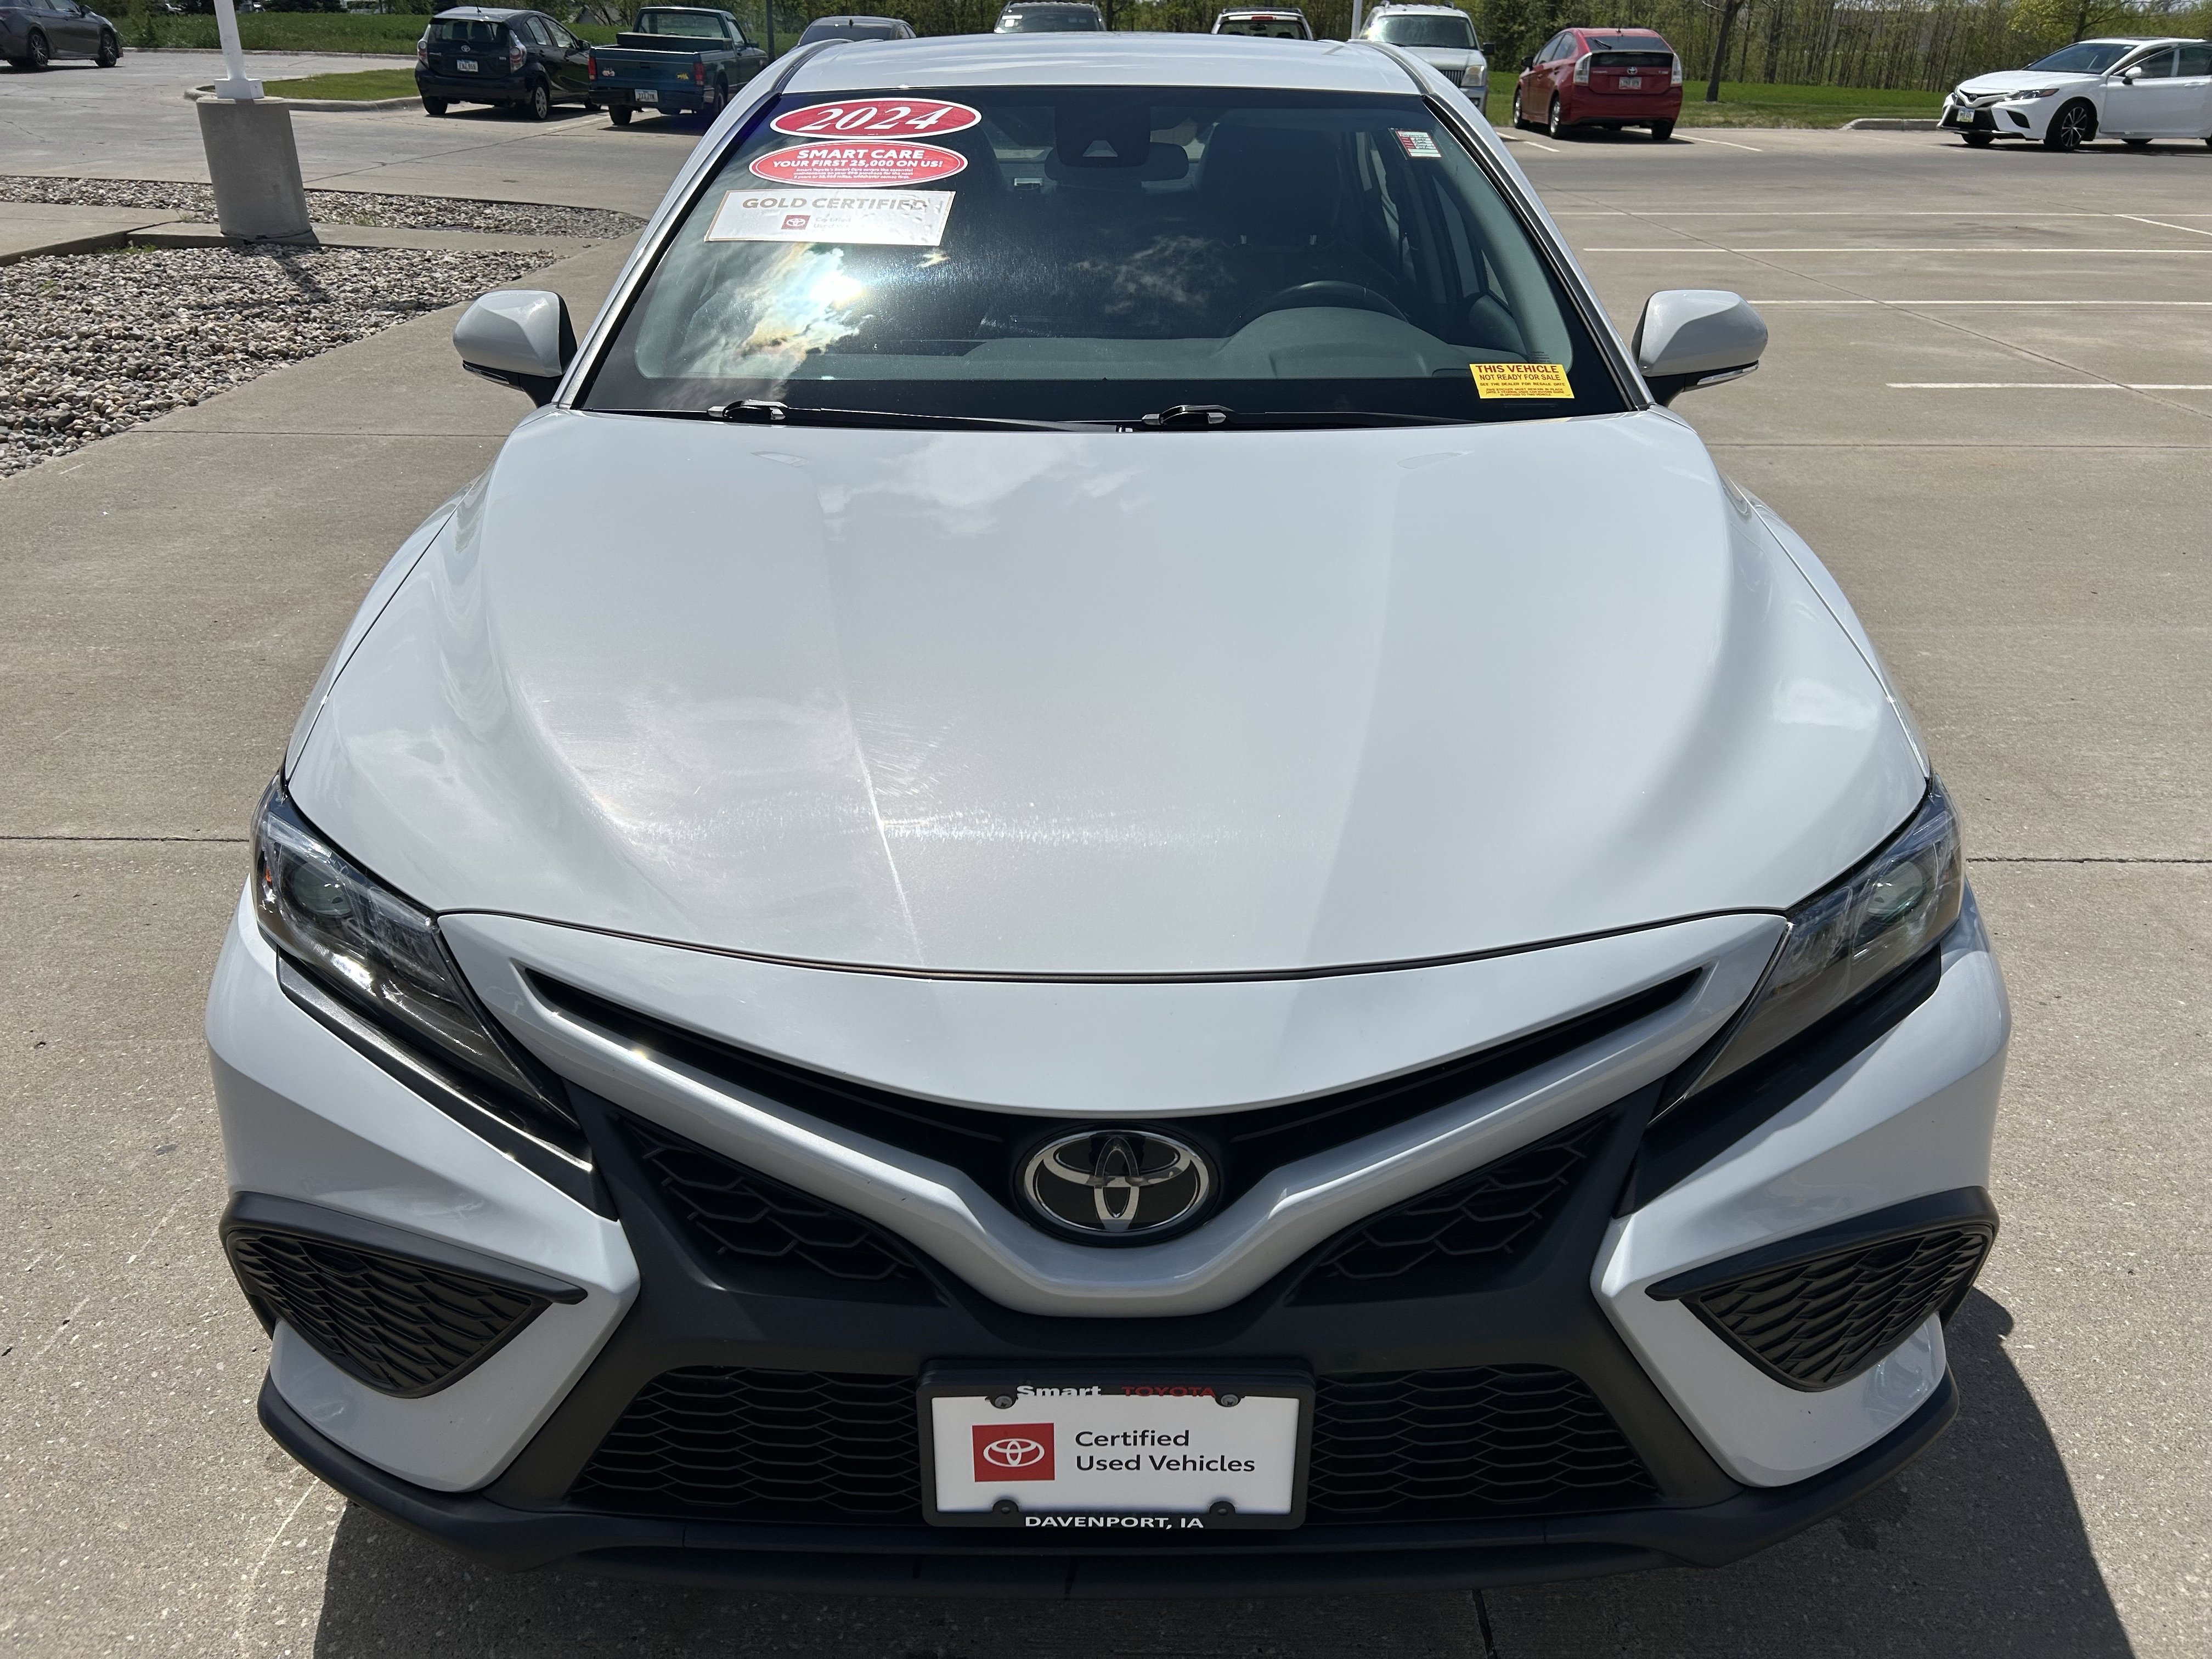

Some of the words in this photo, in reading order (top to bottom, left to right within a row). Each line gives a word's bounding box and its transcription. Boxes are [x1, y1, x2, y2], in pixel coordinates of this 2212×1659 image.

[796, 106, 954, 131] 2024
[797, 149, 869, 159] SMART
[871, 149, 925, 159] CARE
[742, 198, 807, 208] GOLD
[811, 199, 928, 210] CERTIFIED
[1017, 1385, 1102, 1396] Smart
[1121, 1386, 1216, 1398] TOYOTA
[1075, 1430, 1189, 1446] Certified
[1076, 1454, 1141, 1471] Used
[1148, 1454, 1255, 1471] Vehicles
[1025, 1516, 1172, 1530] DAVENPORT,
[1181, 1517, 1204, 1528] IA
